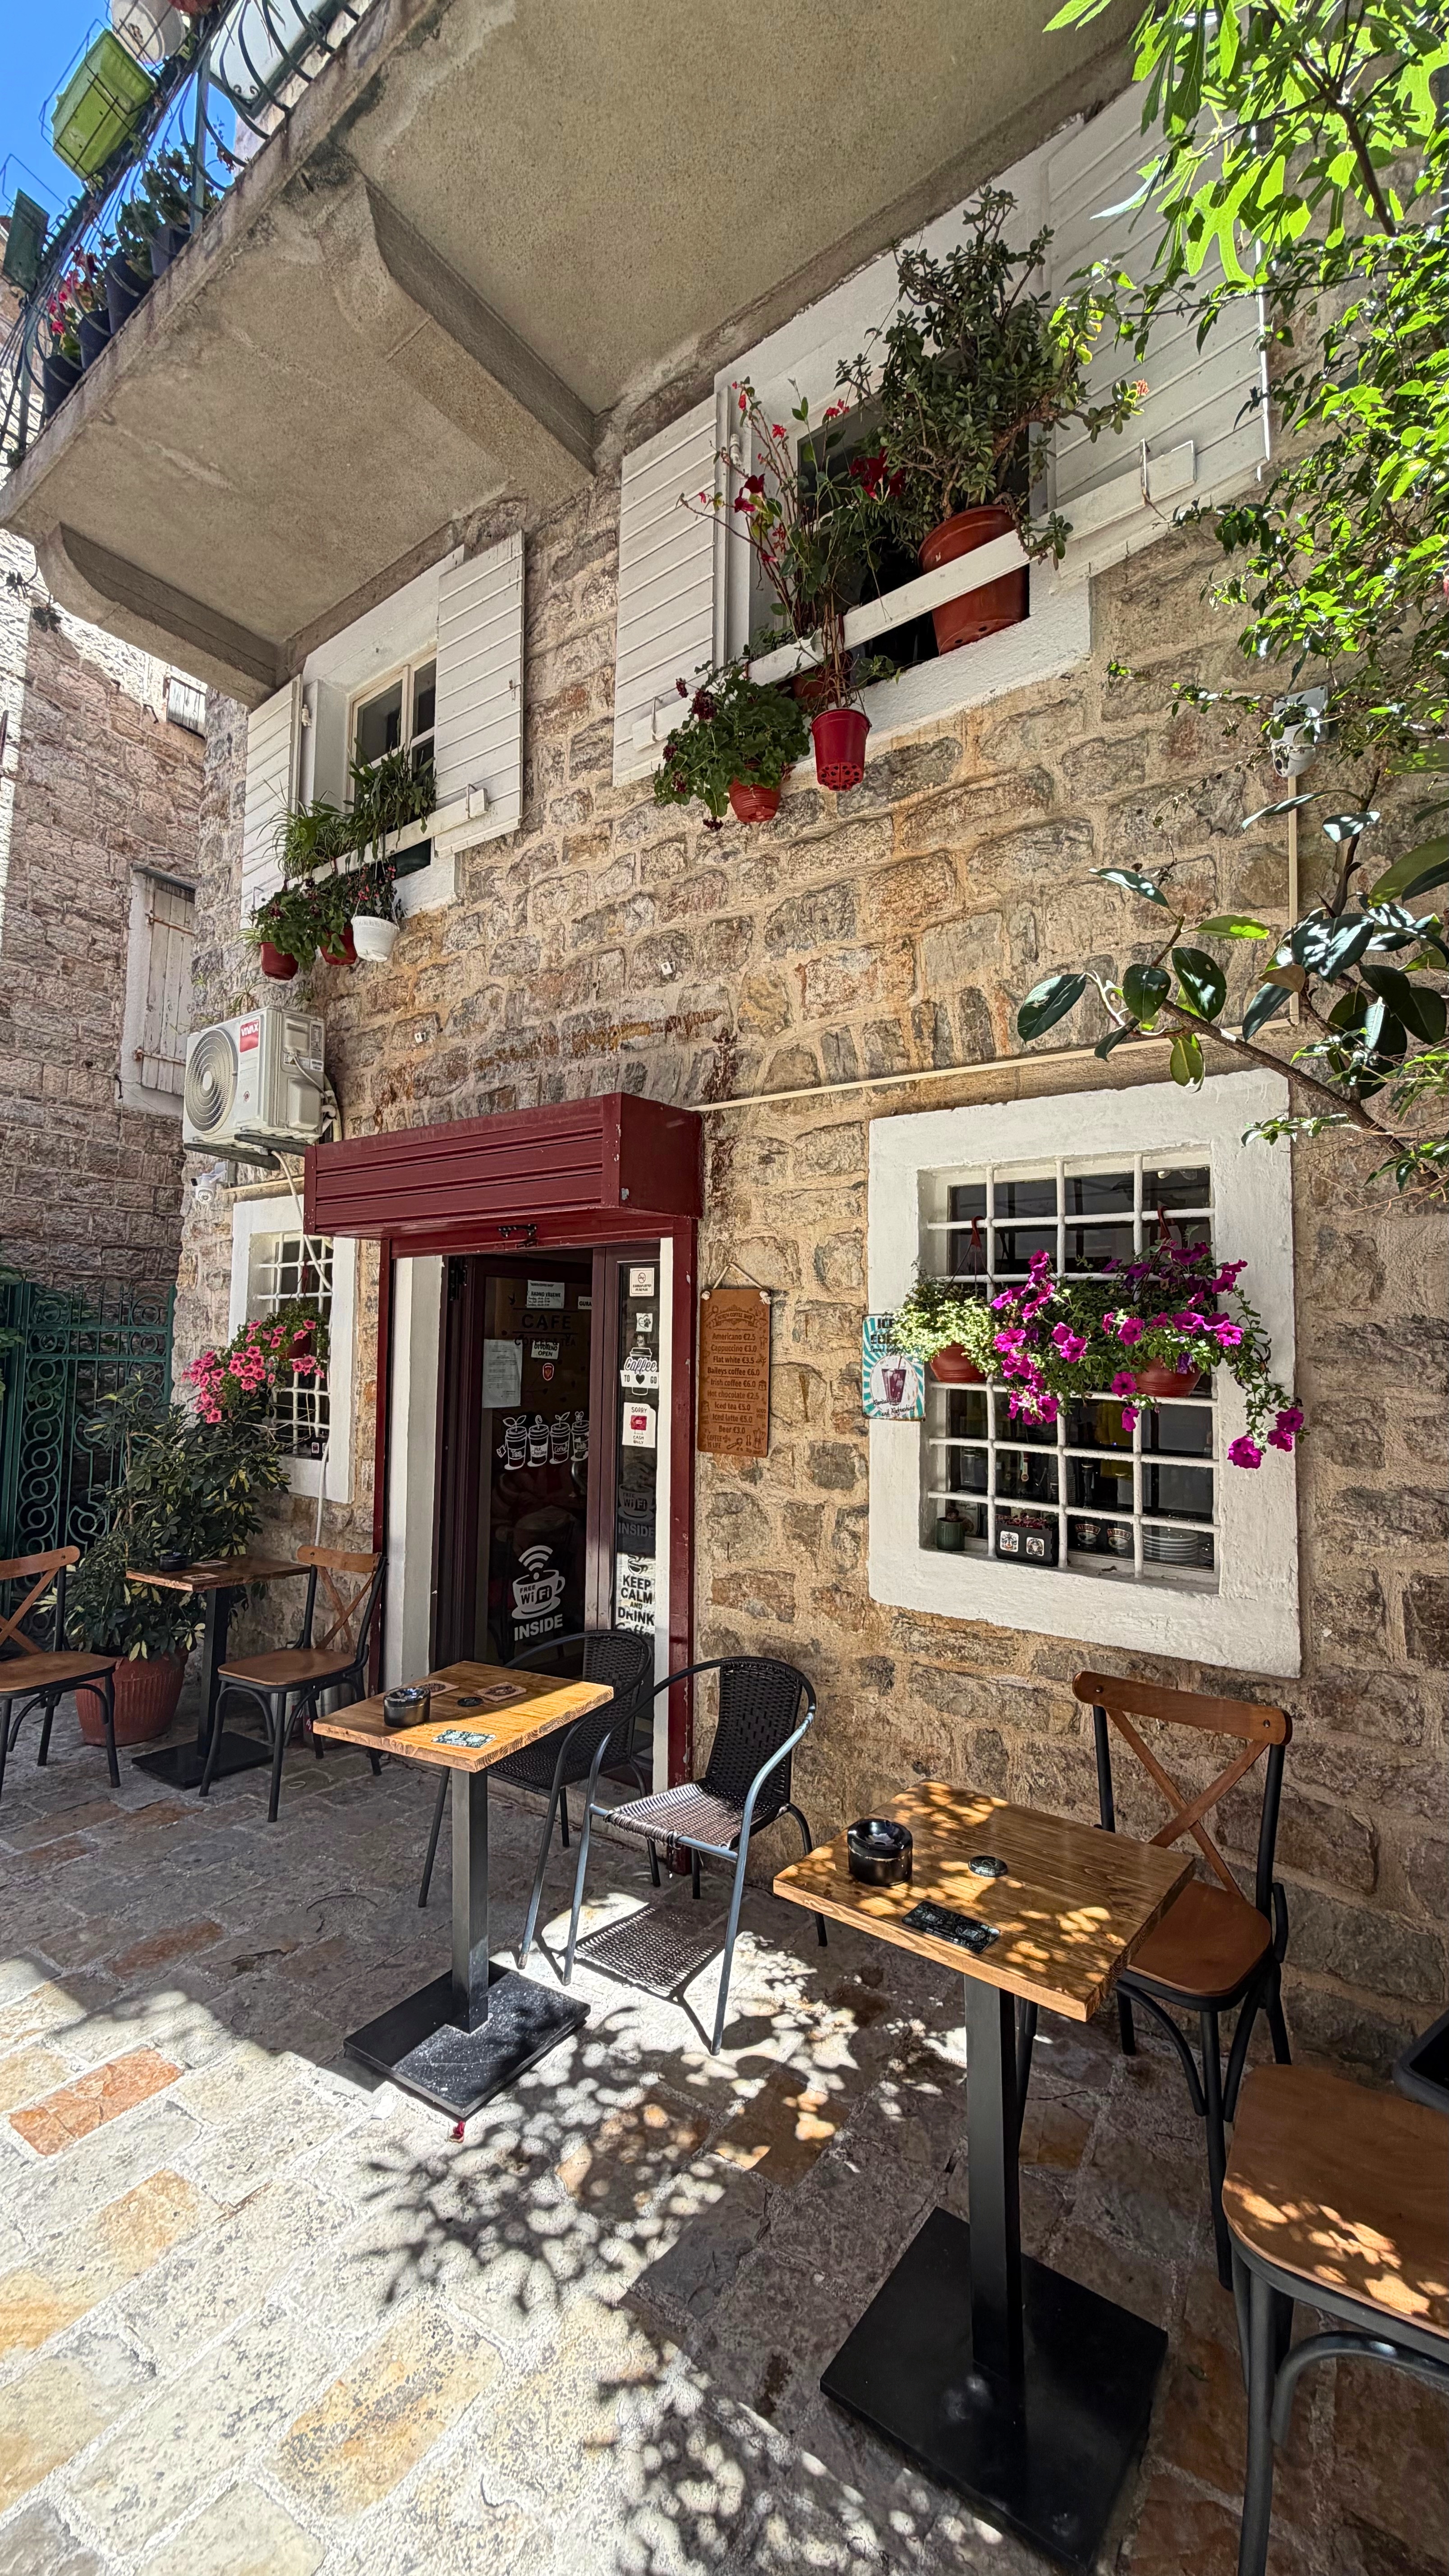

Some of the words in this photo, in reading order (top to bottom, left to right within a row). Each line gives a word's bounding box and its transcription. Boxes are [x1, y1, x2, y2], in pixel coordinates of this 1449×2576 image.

[241, 1023, 258, 1037] VIVAX
[522, 1314, 571, 1329] CAFE
[711, 1344, 743, 1352] Cappuccino
[625, 1358, 657, 1374] Coffee
[707, 1366, 727, 1375] Baileys
[624, 1374, 630, 1382] TO
[650, 1376, 657, 1384] GO
[618, 1522, 654, 1538] INSIDE
[520, 1584, 536, 1593] FREE
[623, 1574, 651, 1590] KEEP
[621, 1587, 653, 1605] CALM
[630, 1601, 643, 1610] AND
[618, 1606, 655, 1626] DRINK
[514, 1614, 563, 1641] INSIDE
